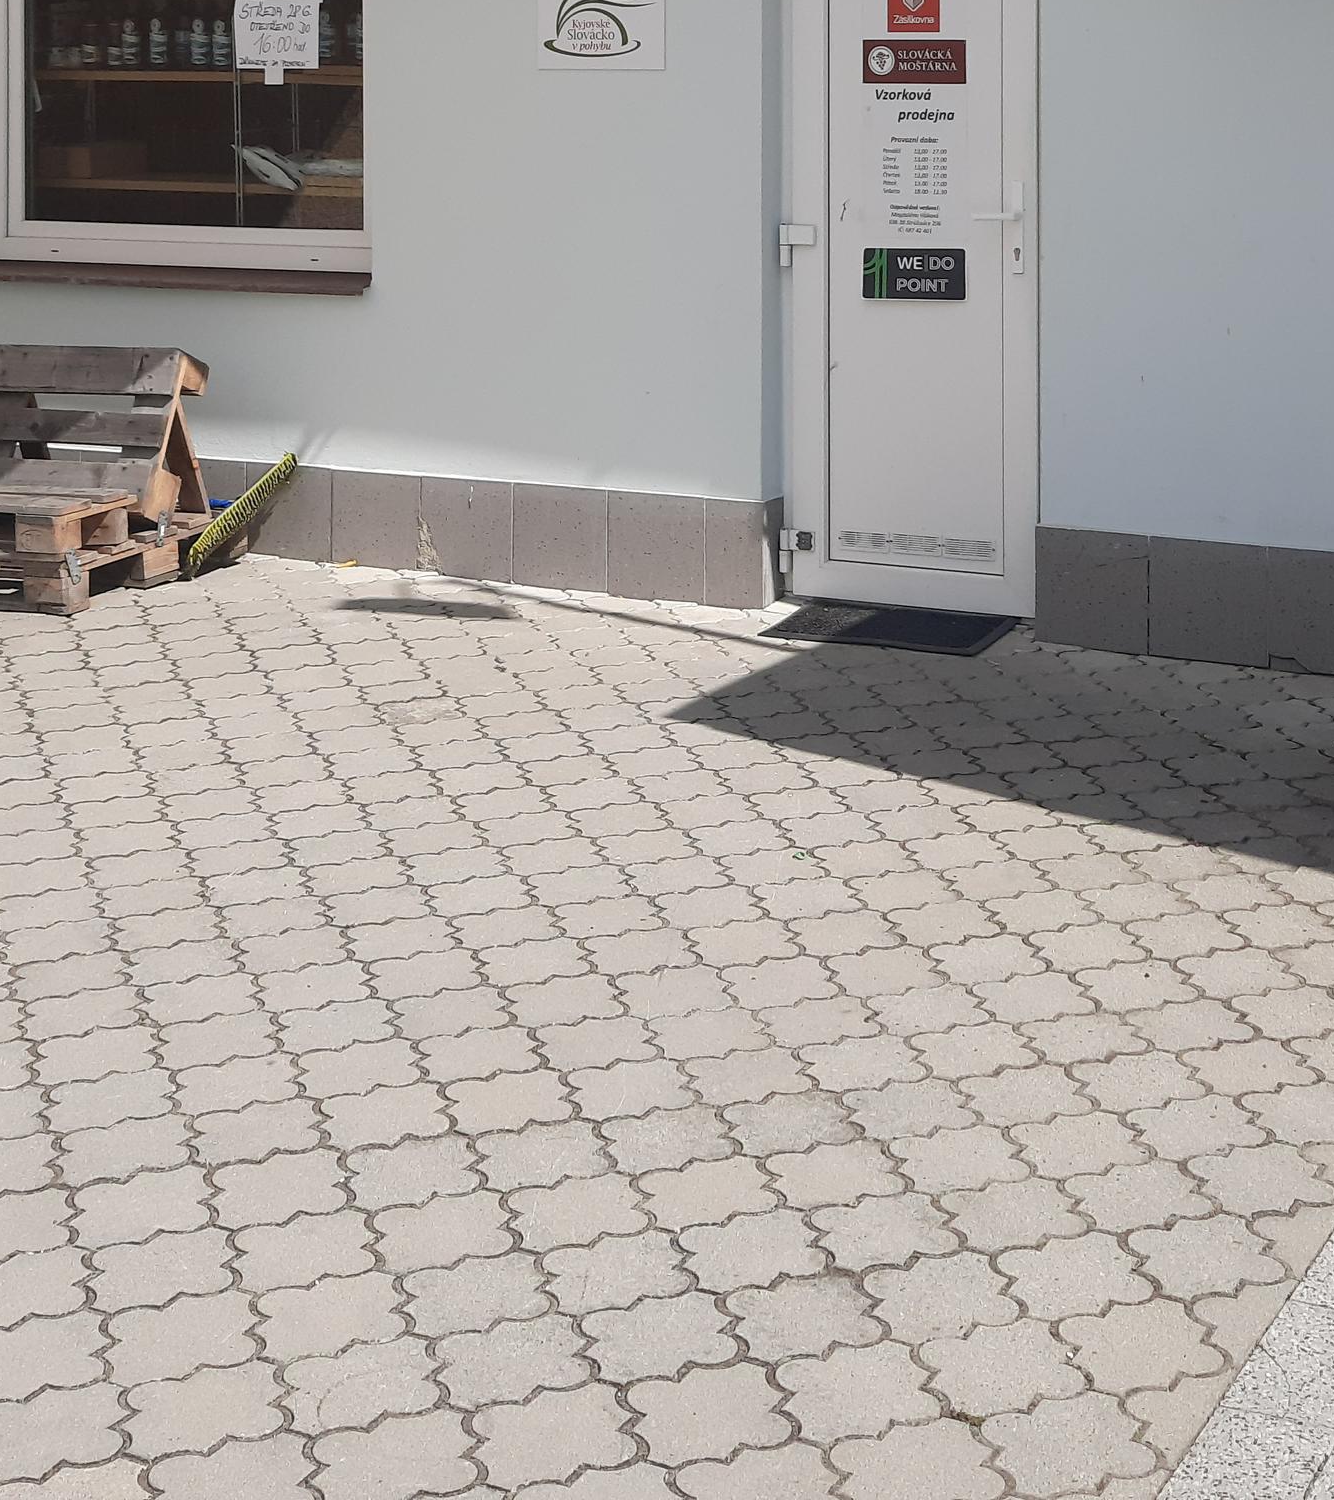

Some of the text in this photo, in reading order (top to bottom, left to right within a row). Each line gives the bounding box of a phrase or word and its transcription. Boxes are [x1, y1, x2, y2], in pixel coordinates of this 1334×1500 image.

[567, 28, 615, 41] Slovácko
[253, 33, 292, 55] 16:00
[579, 41, 612, 52] pohybu
[897, 48, 952, 60] SLOVÁCKÁ
[898, 60, 957, 71] MOŠTÁRNA
[875, 88, 932, 101] Vzorková
[897, 108, 955, 123] prodejna
[896, 278, 949, 293] POINT
